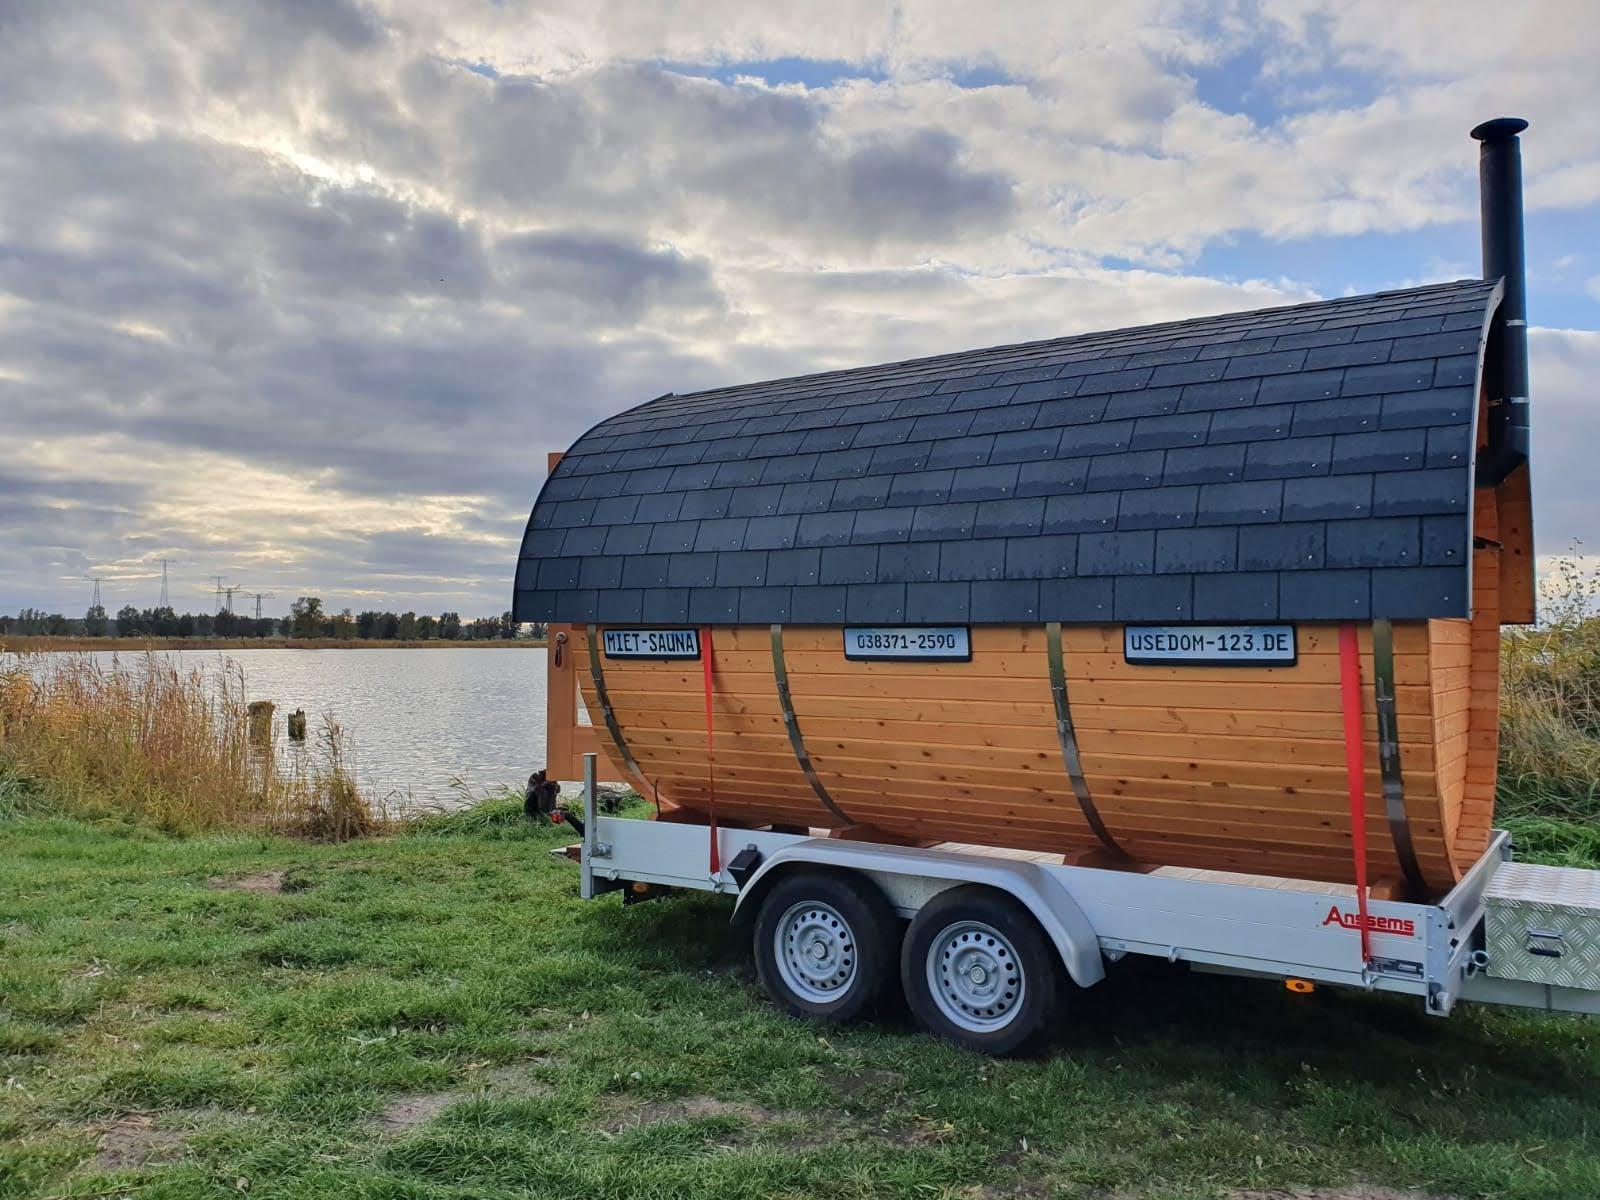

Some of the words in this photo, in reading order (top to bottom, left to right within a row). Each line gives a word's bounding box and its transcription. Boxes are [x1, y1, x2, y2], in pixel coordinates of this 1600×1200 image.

[606, 633, 695, 652] MIET-SAUNA
[857, 634, 956, 649] 038371-2590
[1131, 633, 1289, 651] USEDOM-123.DE
